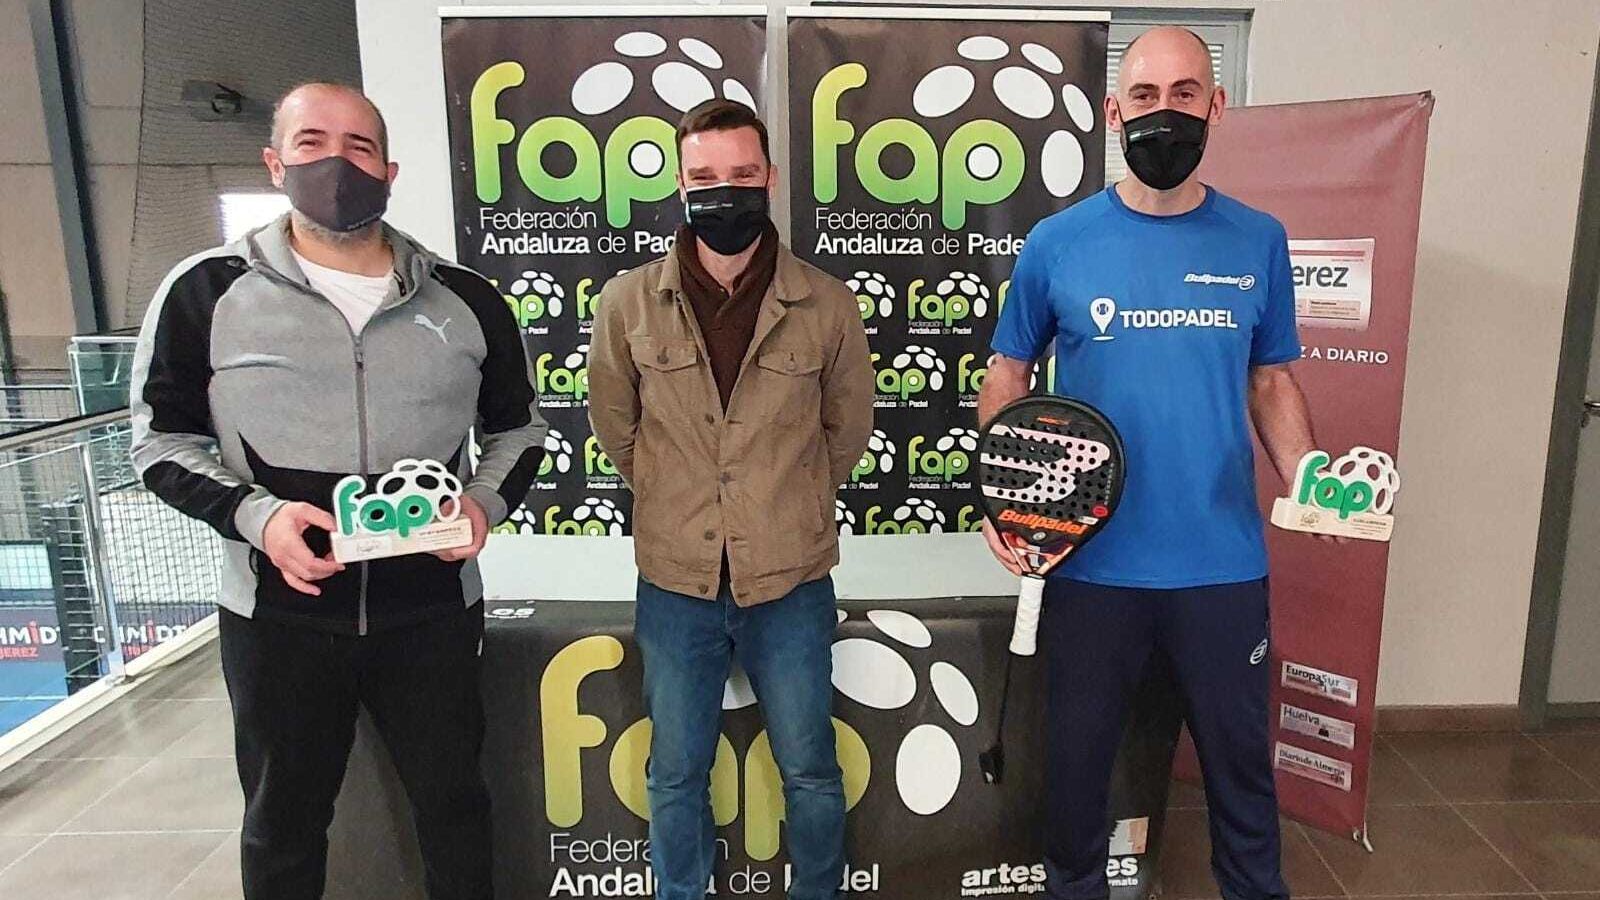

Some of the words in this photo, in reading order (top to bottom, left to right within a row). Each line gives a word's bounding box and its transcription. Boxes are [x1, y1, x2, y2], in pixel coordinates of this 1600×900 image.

[470, 61, 679, 228] fap
[812, 63, 1025, 230] fap
[480, 206, 597, 229] Federación
[815, 207, 932, 230] Federación
[481, 231, 590, 255] Andaluza
[597, 231, 626, 253] de
[635, 231, 678, 254] Pad
[814, 233, 924, 255] Andaluza
[931, 234, 960, 254] de
[968, 234, 1024, 255] Pade
[1292, 264, 1349, 288] erez
[908, 279, 970, 327] fap
[1120, 309, 1238, 329] TODOPADEL
[1310, 347, 1322, 359] A
[1327, 348, 1389, 364] DIARIO
[908, 436, 969, 482] fap
[1298, 455, 1373, 520] fap
[338, 480, 433, 538] fap
[999, 509, 1089, 535] Bullpadel
[1283, 706, 1320, 726] Huelva
[729, 864, 771, 893] de
[961, 862, 1047, 888] artes
